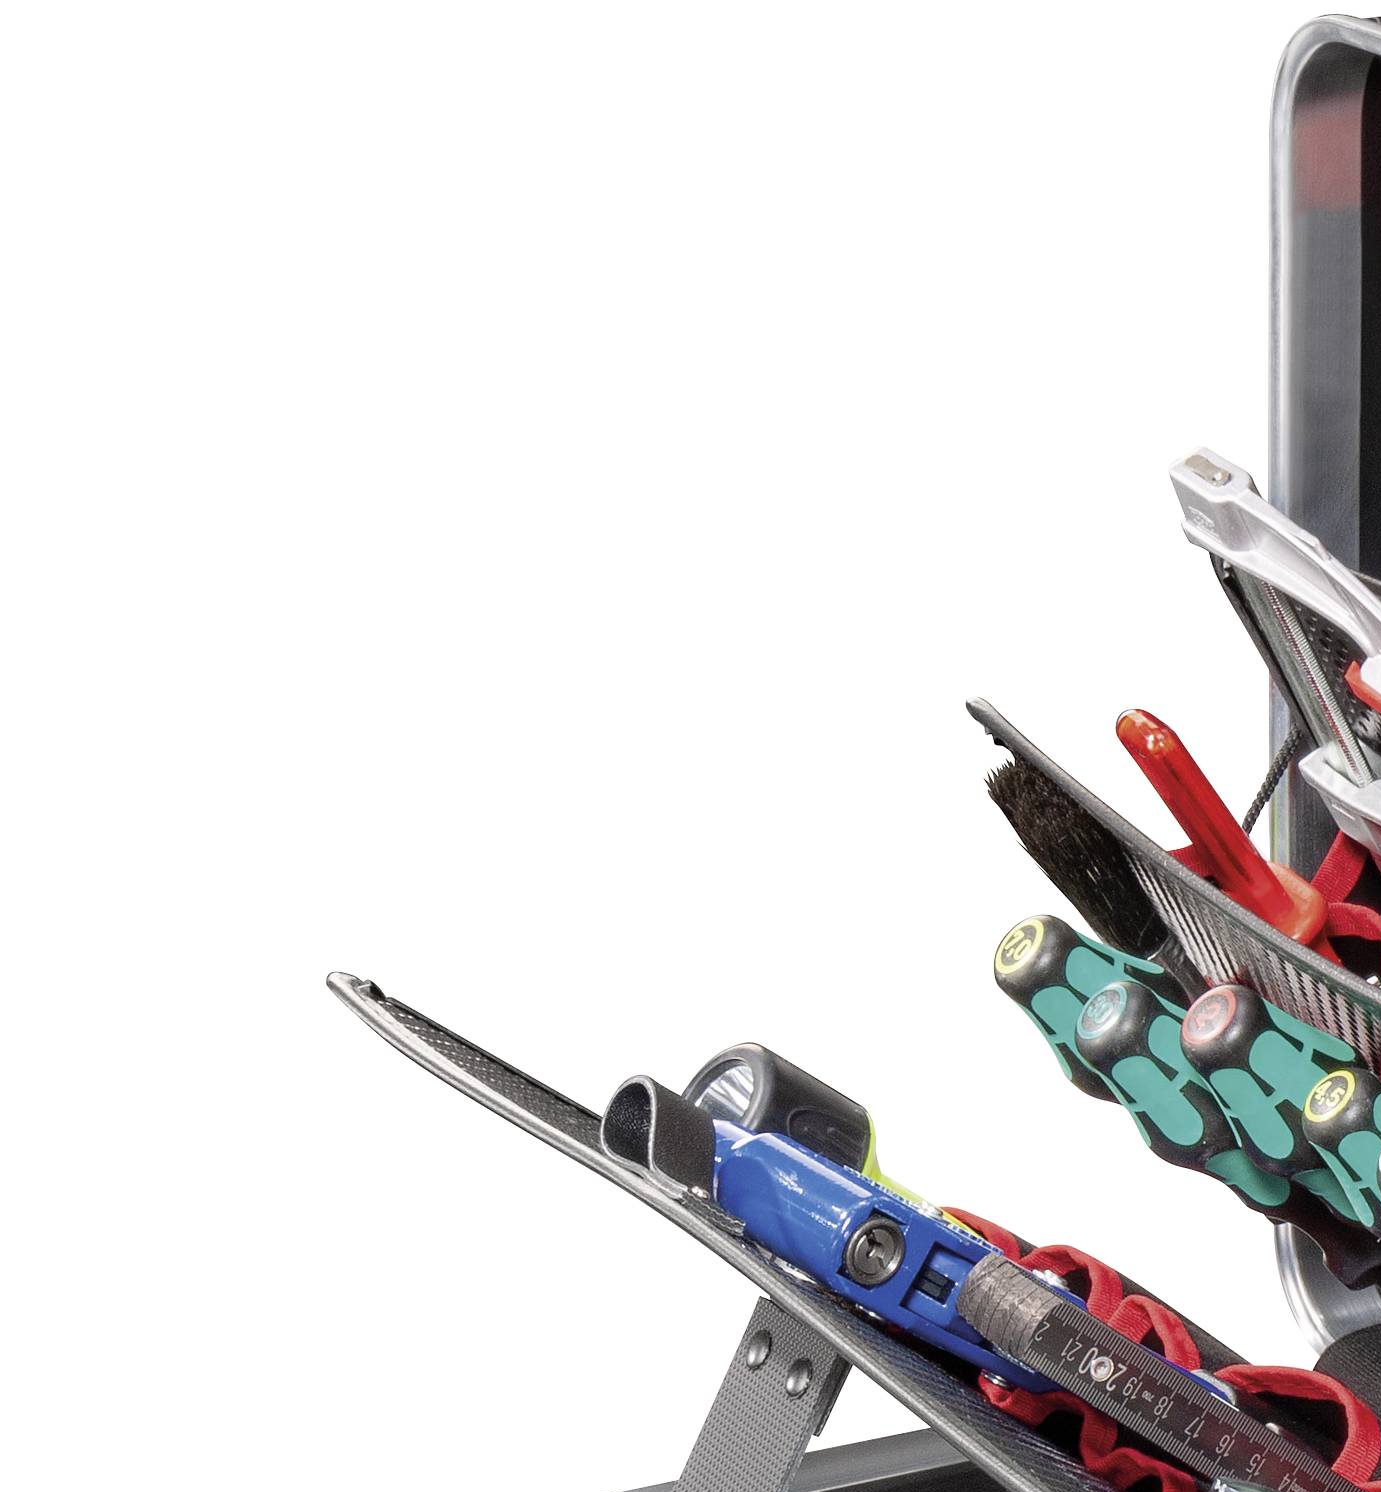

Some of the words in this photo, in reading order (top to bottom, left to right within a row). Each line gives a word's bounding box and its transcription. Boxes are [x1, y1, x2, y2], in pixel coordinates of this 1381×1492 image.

[1061, 1338, 1082, 1361] 21
[1122, 1376, 1142, 1400] 19
[1153, 1396, 1174, 1419] 18
[1184, 1416, 1205, 1438] 17
[1215, 1434, 1236, 1457] 16
[1246, 1454, 1266, 1476] 15
